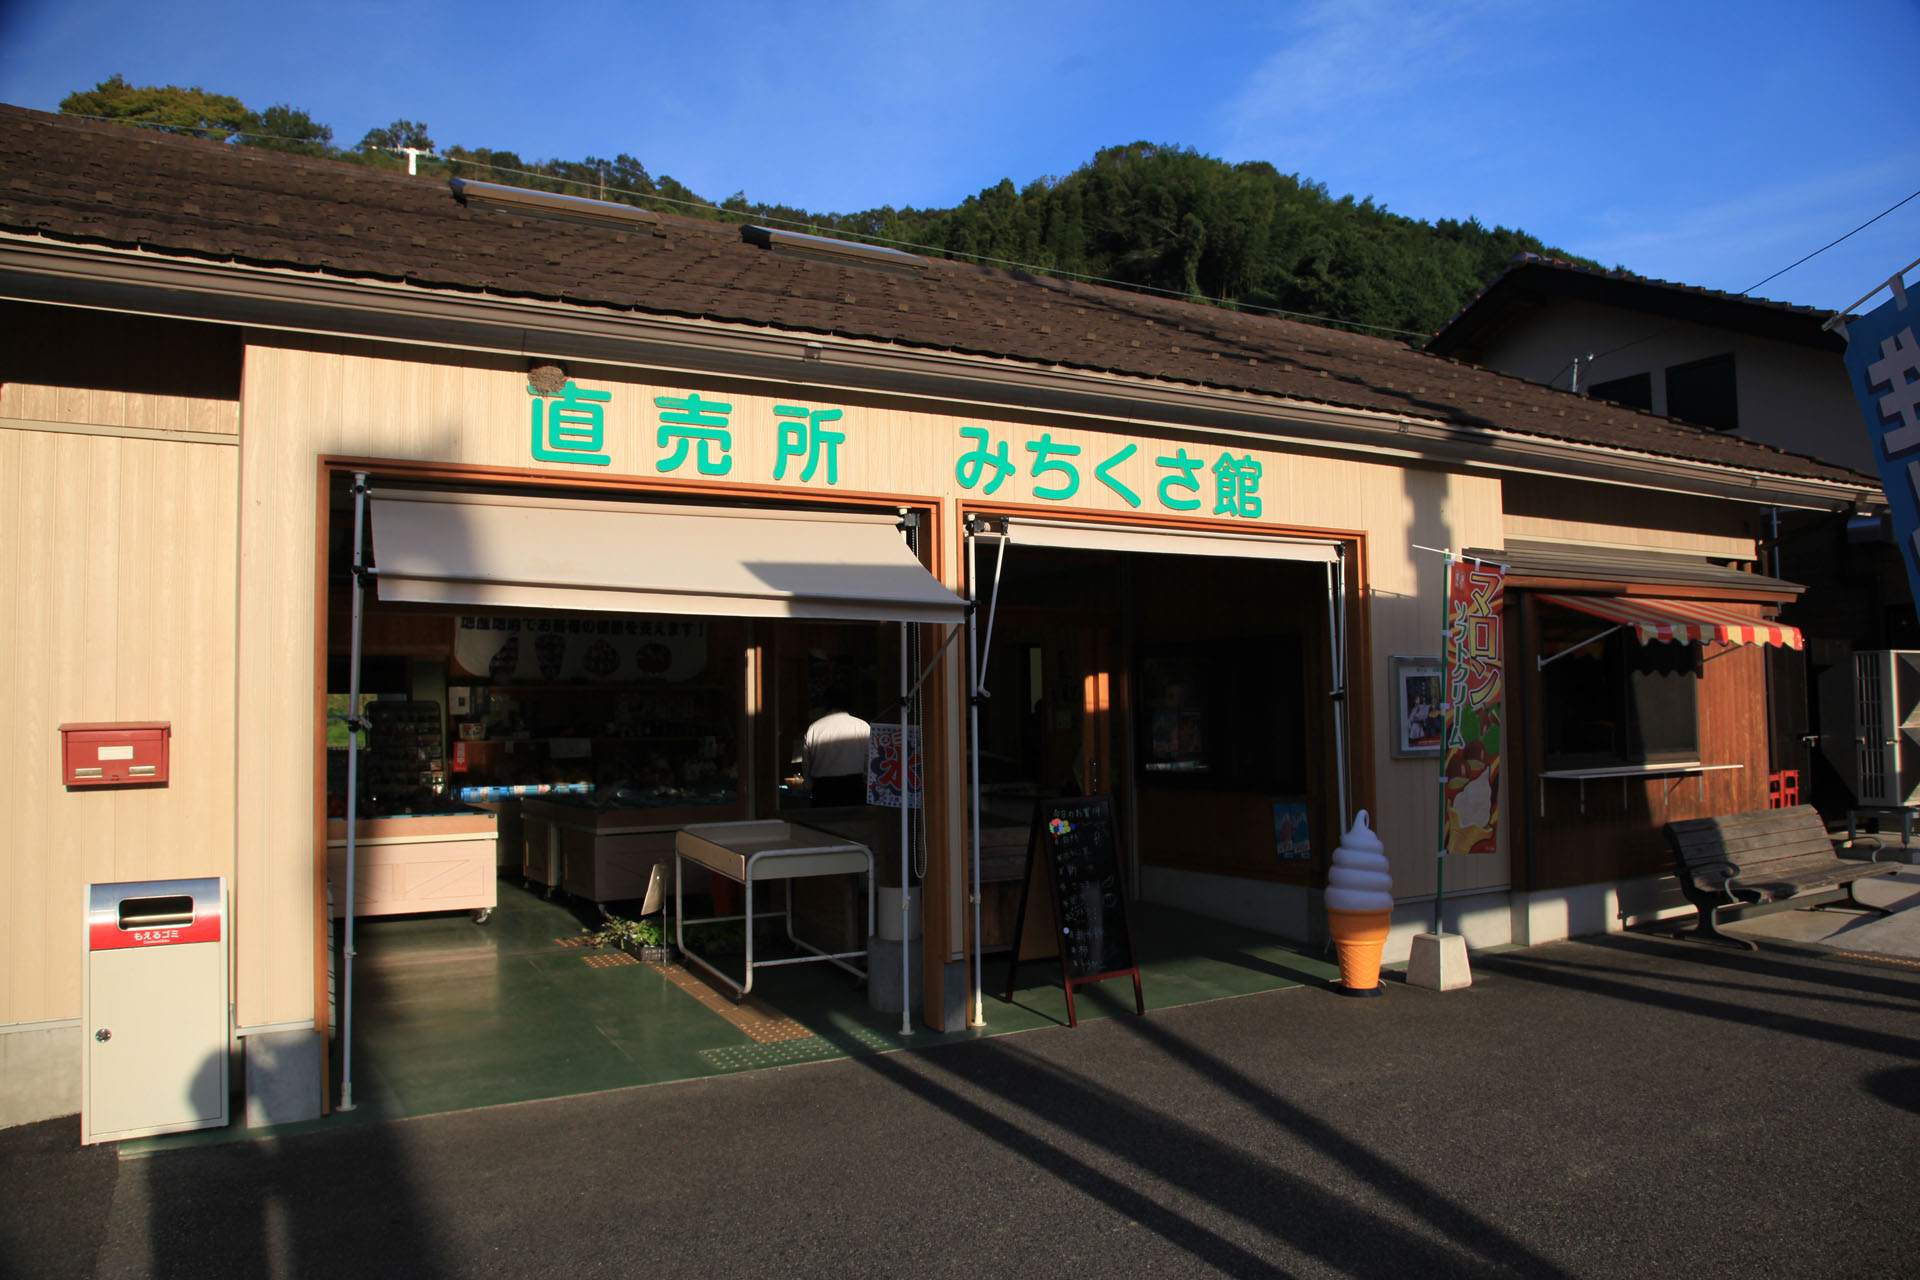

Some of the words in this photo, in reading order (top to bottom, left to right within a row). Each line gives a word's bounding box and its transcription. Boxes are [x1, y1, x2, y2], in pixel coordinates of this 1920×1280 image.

[528, 379, 846, 485] 直売所
[956, 426, 1263, 518] みちくさ館
[1449, 600, 1469, 748] ソフトクリーム
[1469, 573, 1501, 706] マロン
[879, 744, 921, 790] 氷
[134, 930, 179, 941] もえるゴミ
